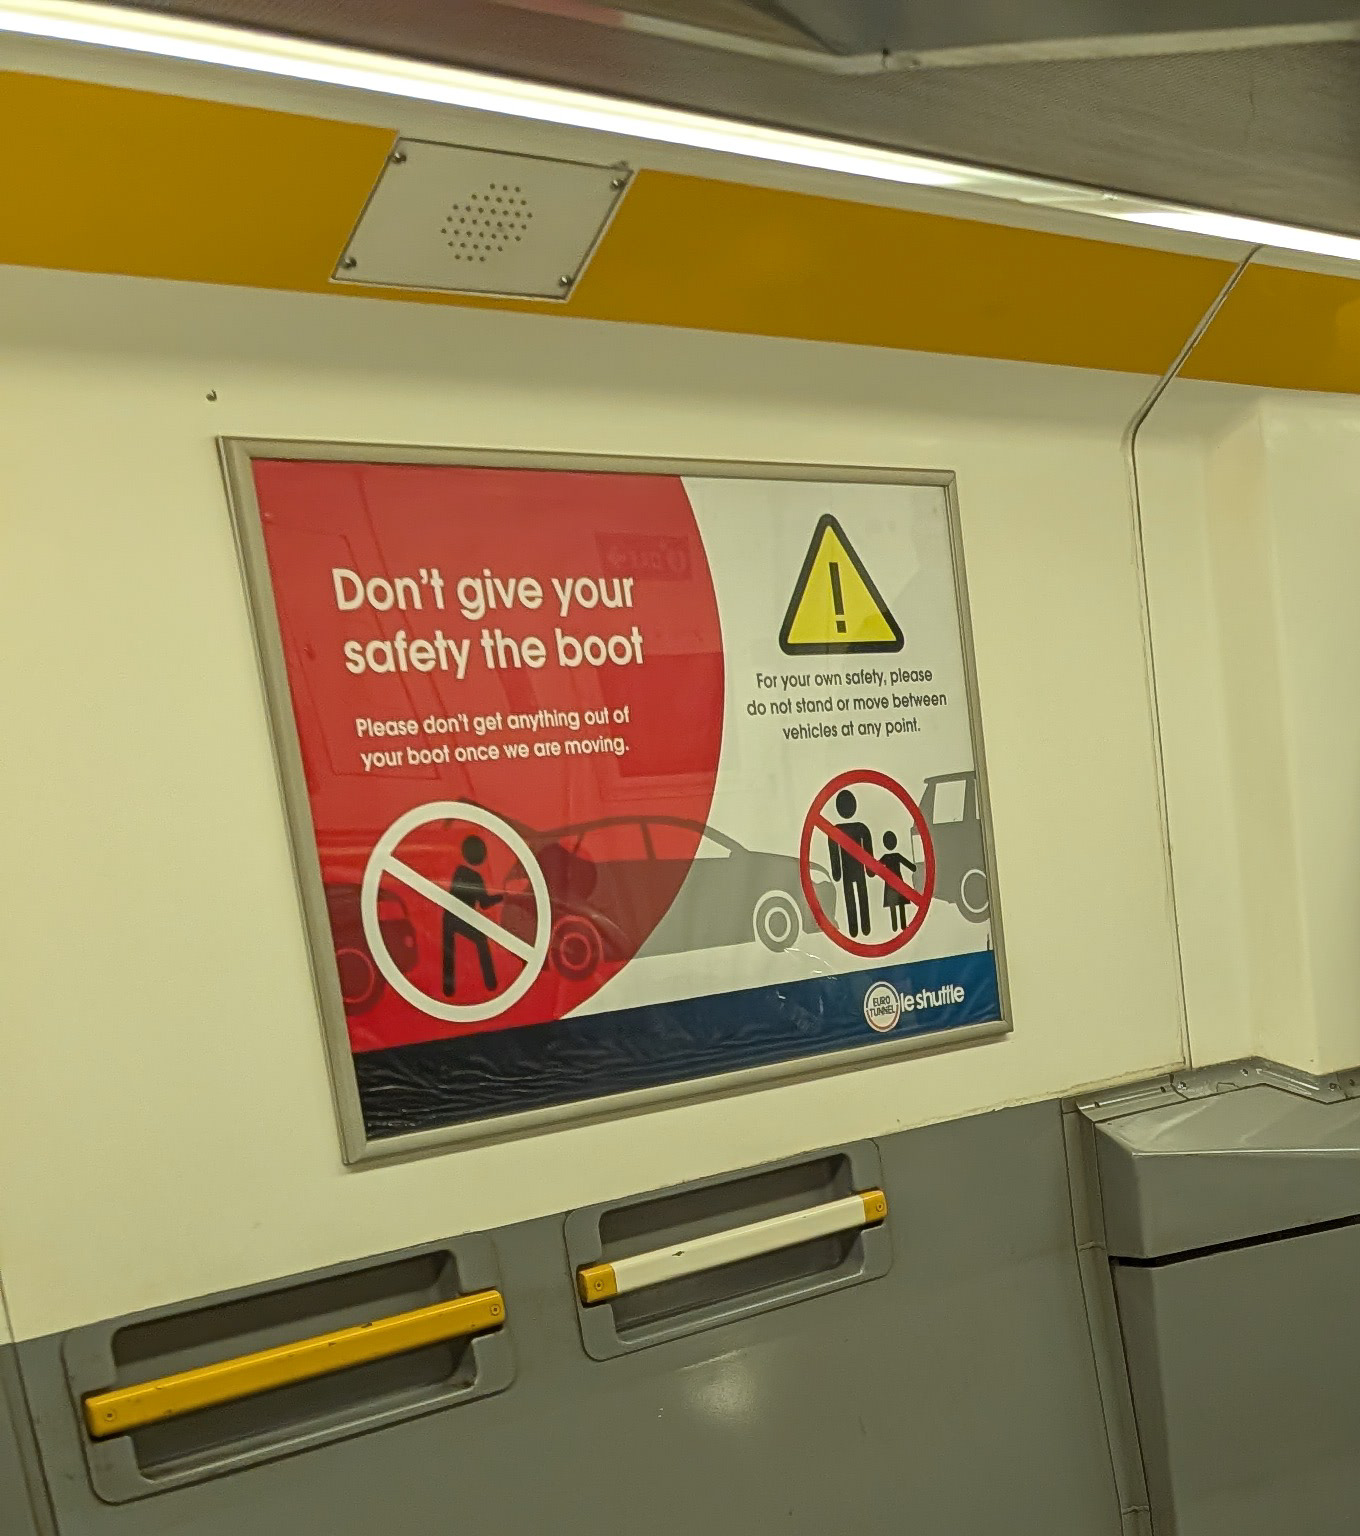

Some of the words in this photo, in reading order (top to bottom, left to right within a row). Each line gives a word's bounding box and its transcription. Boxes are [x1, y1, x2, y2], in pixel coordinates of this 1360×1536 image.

[332, 567, 445, 611] Don't
[456, 568, 543, 620] give
[551, 576, 634, 617] your
[343, 629, 471, 680] safety
[480, 628, 547, 669] the
[554, 626, 644, 668] boot
[756, 672, 777, 689] For
[781, 673, 811, 691] your
[814, 672, 842, 686] own
[845, 668, 887, 687] safety,
[890, 668, 933, 686] please
[746, 700, 767, 716] do
[770, 698, 792, 714] not
[796, 696, 833, 714] stand
[836, 697, 850, 711] or
[853, 694, 889, 711] move
[892, 693, 948, 708] between
[355, 717, 418, 738] Please
[422, 713, 469, 735] don't
[473, 712, 503, 736] get
[507, 709, 580, 732] anything
[584, 707, 609, 726] out
[613, 705, 630, 723] of
[782, 722, 838, 739] vehicles
[841, 720, 854, 736] at
[857, 721, 881, 738] any
[885, 717, 921, 737] point.
[360, 750, 403, 772] your
[407, 746, 451, 765] boot
[454, 743, 500, 763] once
[503, 743, 529, 759] we
[533, 740, 561, 757] are
[564, 735, 630, 756] moving.
[869, 1004, 896, 1018] TUNNEL
[872, 995, 891, 1007] EURO
